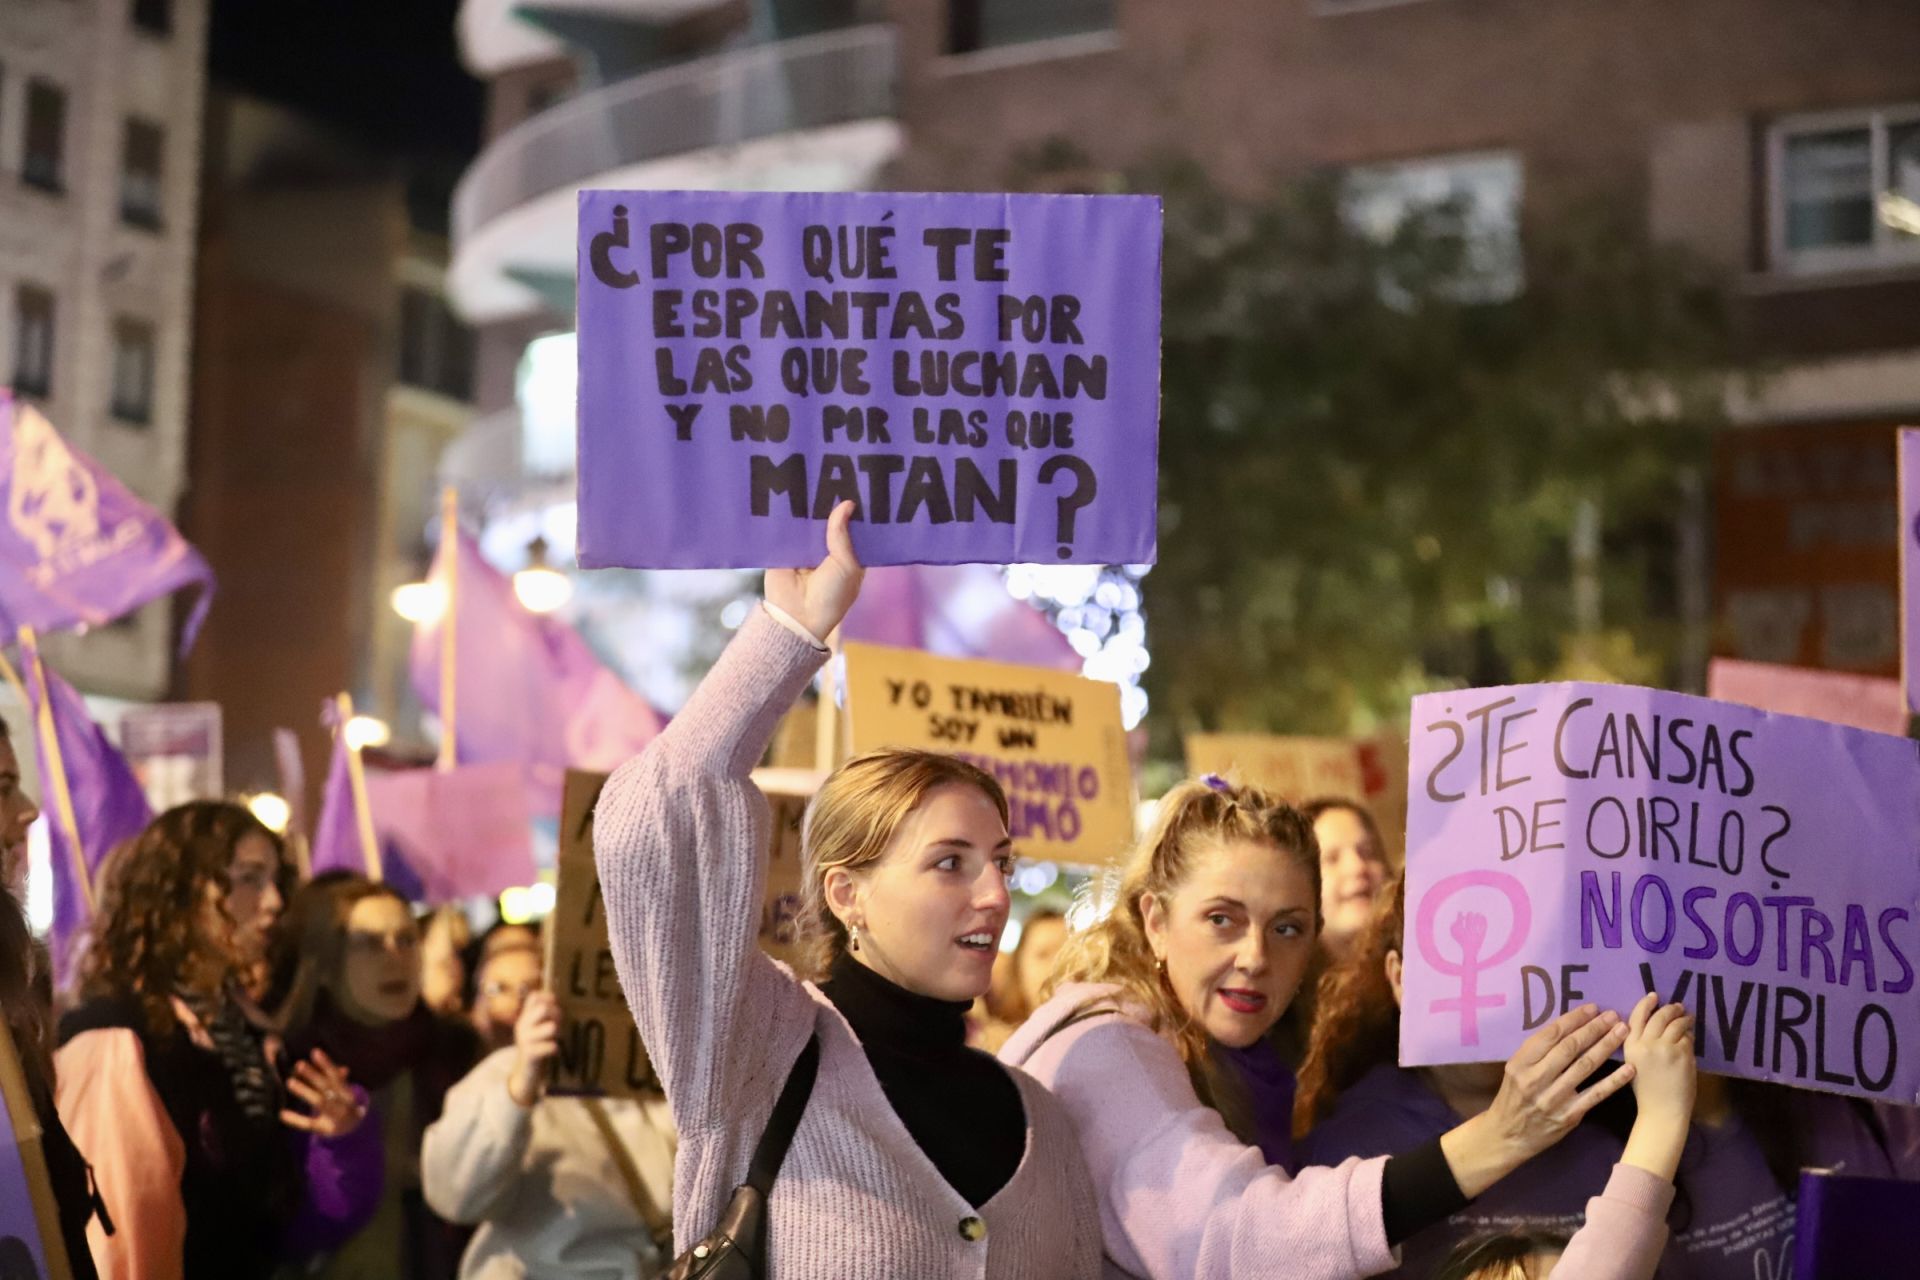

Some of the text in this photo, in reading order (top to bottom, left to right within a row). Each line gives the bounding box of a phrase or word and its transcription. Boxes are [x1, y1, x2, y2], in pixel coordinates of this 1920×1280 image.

[590, 205, 1010, 288] ¿POR QUÉ TE
[652, 290, 1084, 345] ESPANTAS POR
[655, 345, 1107, 400] LAS QUE LUCHAN
[664, 404, 1073, 451] Y NO POR LAS QUE
[886, 680, 1072, 724] YO TAMBIÉN
[929, 715, 1036, 749] SOY UN
[1425, 696, 1537, 802] ¿TE
[1554, 698, 1755, 797] CANSAS
[1493, 796, 1791, 890] DE OIRLO?
[1580, 870, 1915, 994] NOSOTRAS
[570, 950, 626, 1002] LE
